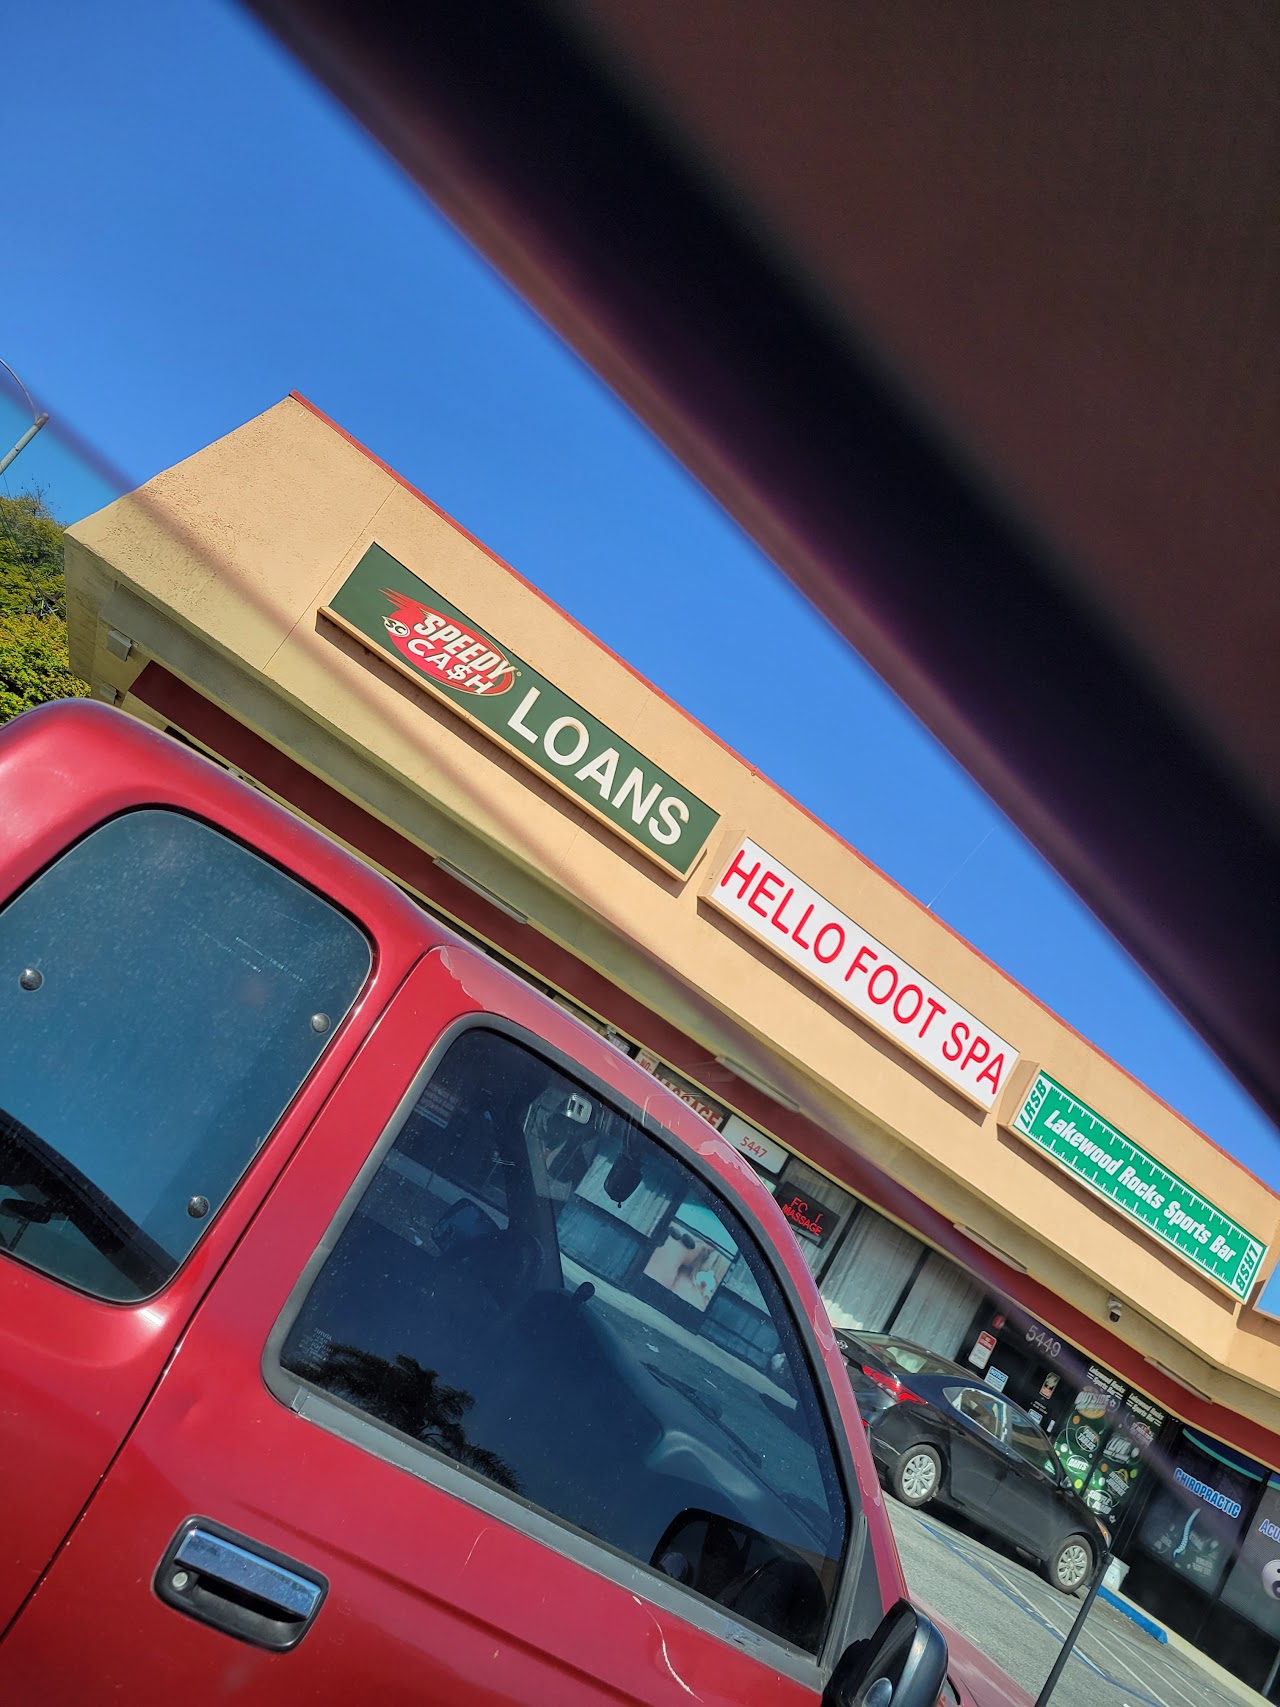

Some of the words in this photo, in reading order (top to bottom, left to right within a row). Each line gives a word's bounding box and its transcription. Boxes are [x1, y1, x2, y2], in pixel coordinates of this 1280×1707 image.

[385, 619, 407, 635] SC
[413, 608, 517, 680] SPEEDY
[407, 638, 494, 694] CA$H
[508, 686, 690, 845] LOANS
[721, 850, 845, 963] HELLO
[844, 946, 946, 1038] FOOT
[942, 1022, 1004, 1094] SPA
[1020, 1079, 1047, 1130] LRSB
[740, 1136, 767, 1158] 5447
[1044, 1110, 1124, 1176] Lakewood
[1117, 1166, 1165, 1209] Rocks
[1164, 1201, 1212, 1244] Sports
[1209, 1235, 1237, 1263] Bar
[782, 1204, 823, 1236] MASSAGE
[1236, 1243, 1259, 1290] LRSB
[1025, 1325, 1061, 1357] 5449
[1089, 1366, 1113, 1384] Lakewood
[1110, 1379, 1126, 1393] Rocks
[1093, 1377, 1108, 1391] Sports
[1107, 1387, 1117, 1397] Bar
[1129, 1393, 1152, 1411] Lakewood
[1149, 1406, 1165, 1420] Rocks
[1132, 1403, 1148, 1417] Sports
[1147, 1413, 1156, 1422] Bar
[1077, 1435, 1097, 1451] TABLES
[1068, 1459, 1089, 1471] DARTS
[1173, 1468, 1241, 1518] CHIROPRACTIC
